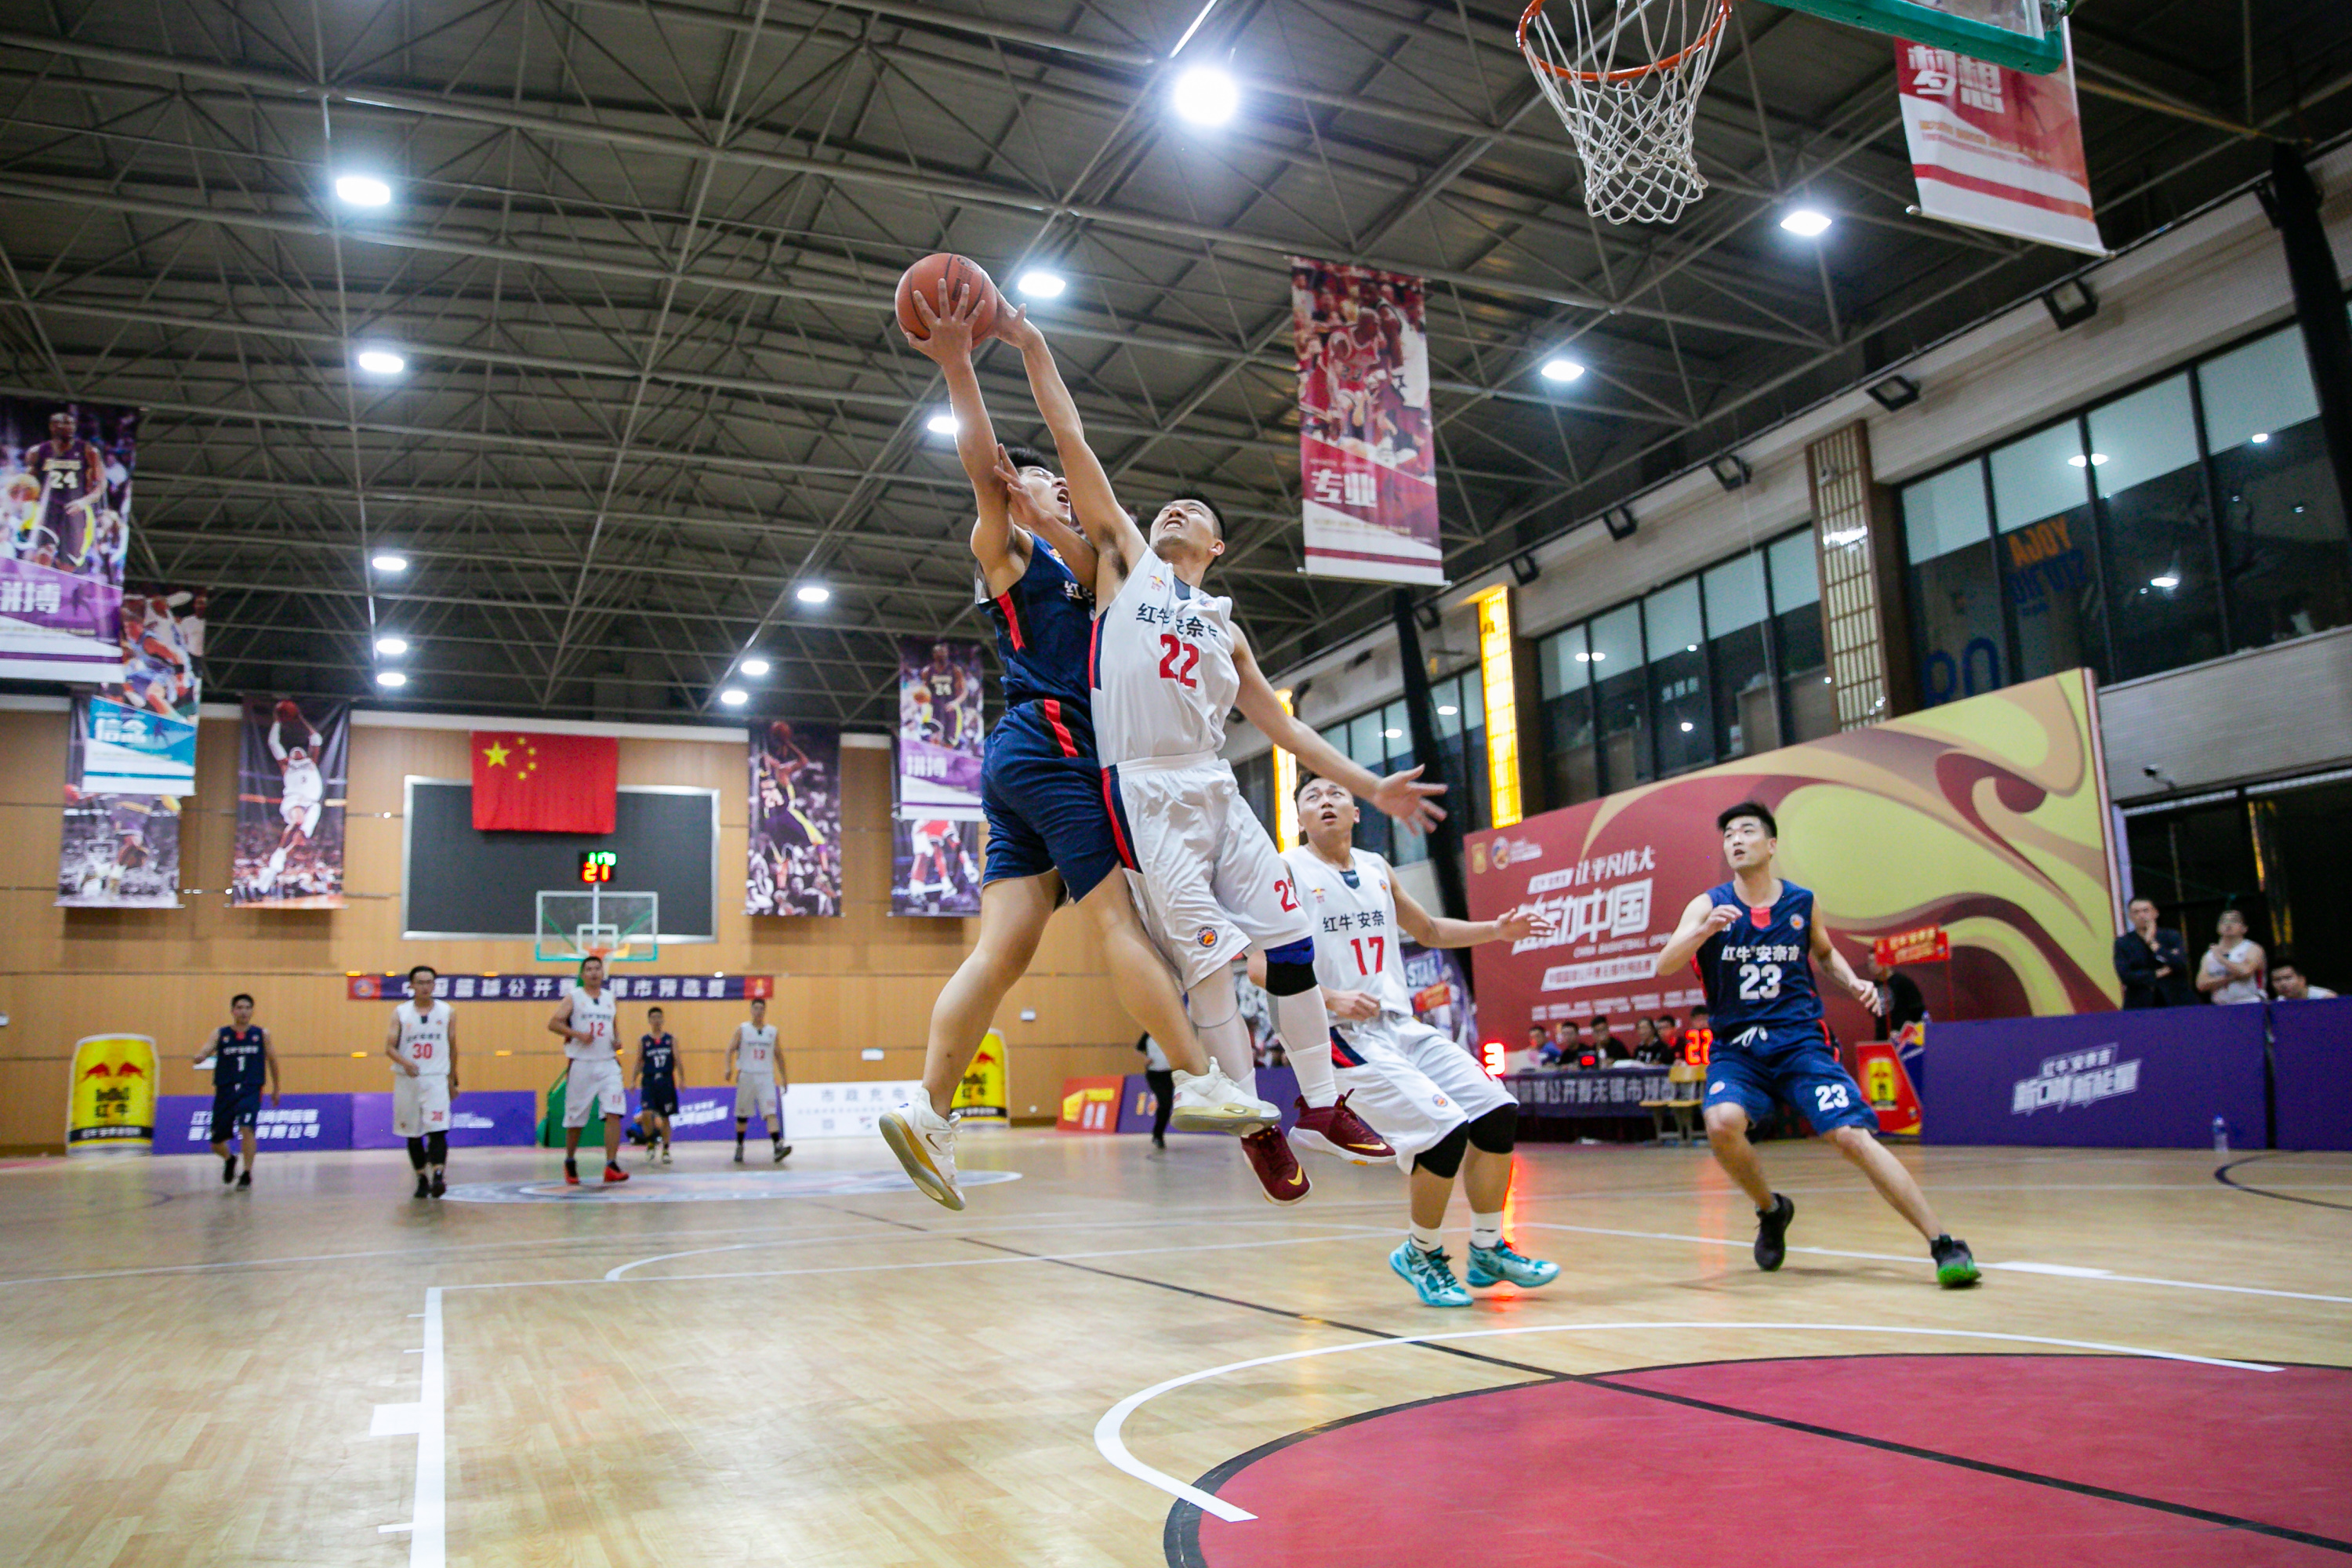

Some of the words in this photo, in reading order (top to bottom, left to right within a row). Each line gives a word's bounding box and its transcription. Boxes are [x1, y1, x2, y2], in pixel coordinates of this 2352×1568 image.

[49, 470, 78, 489] 24
[1309, 468, 1377, 508] 专业
[1160, 633, 1200, 689] 22
[1350, 936, 1385, 976] 17
[1739, 964, 1782, 1000] 23
[237, 1056, 245, 1073] 1
[412, 1043, 433, 1059] 30
[1815, 1083, 1849, 1112] 23
